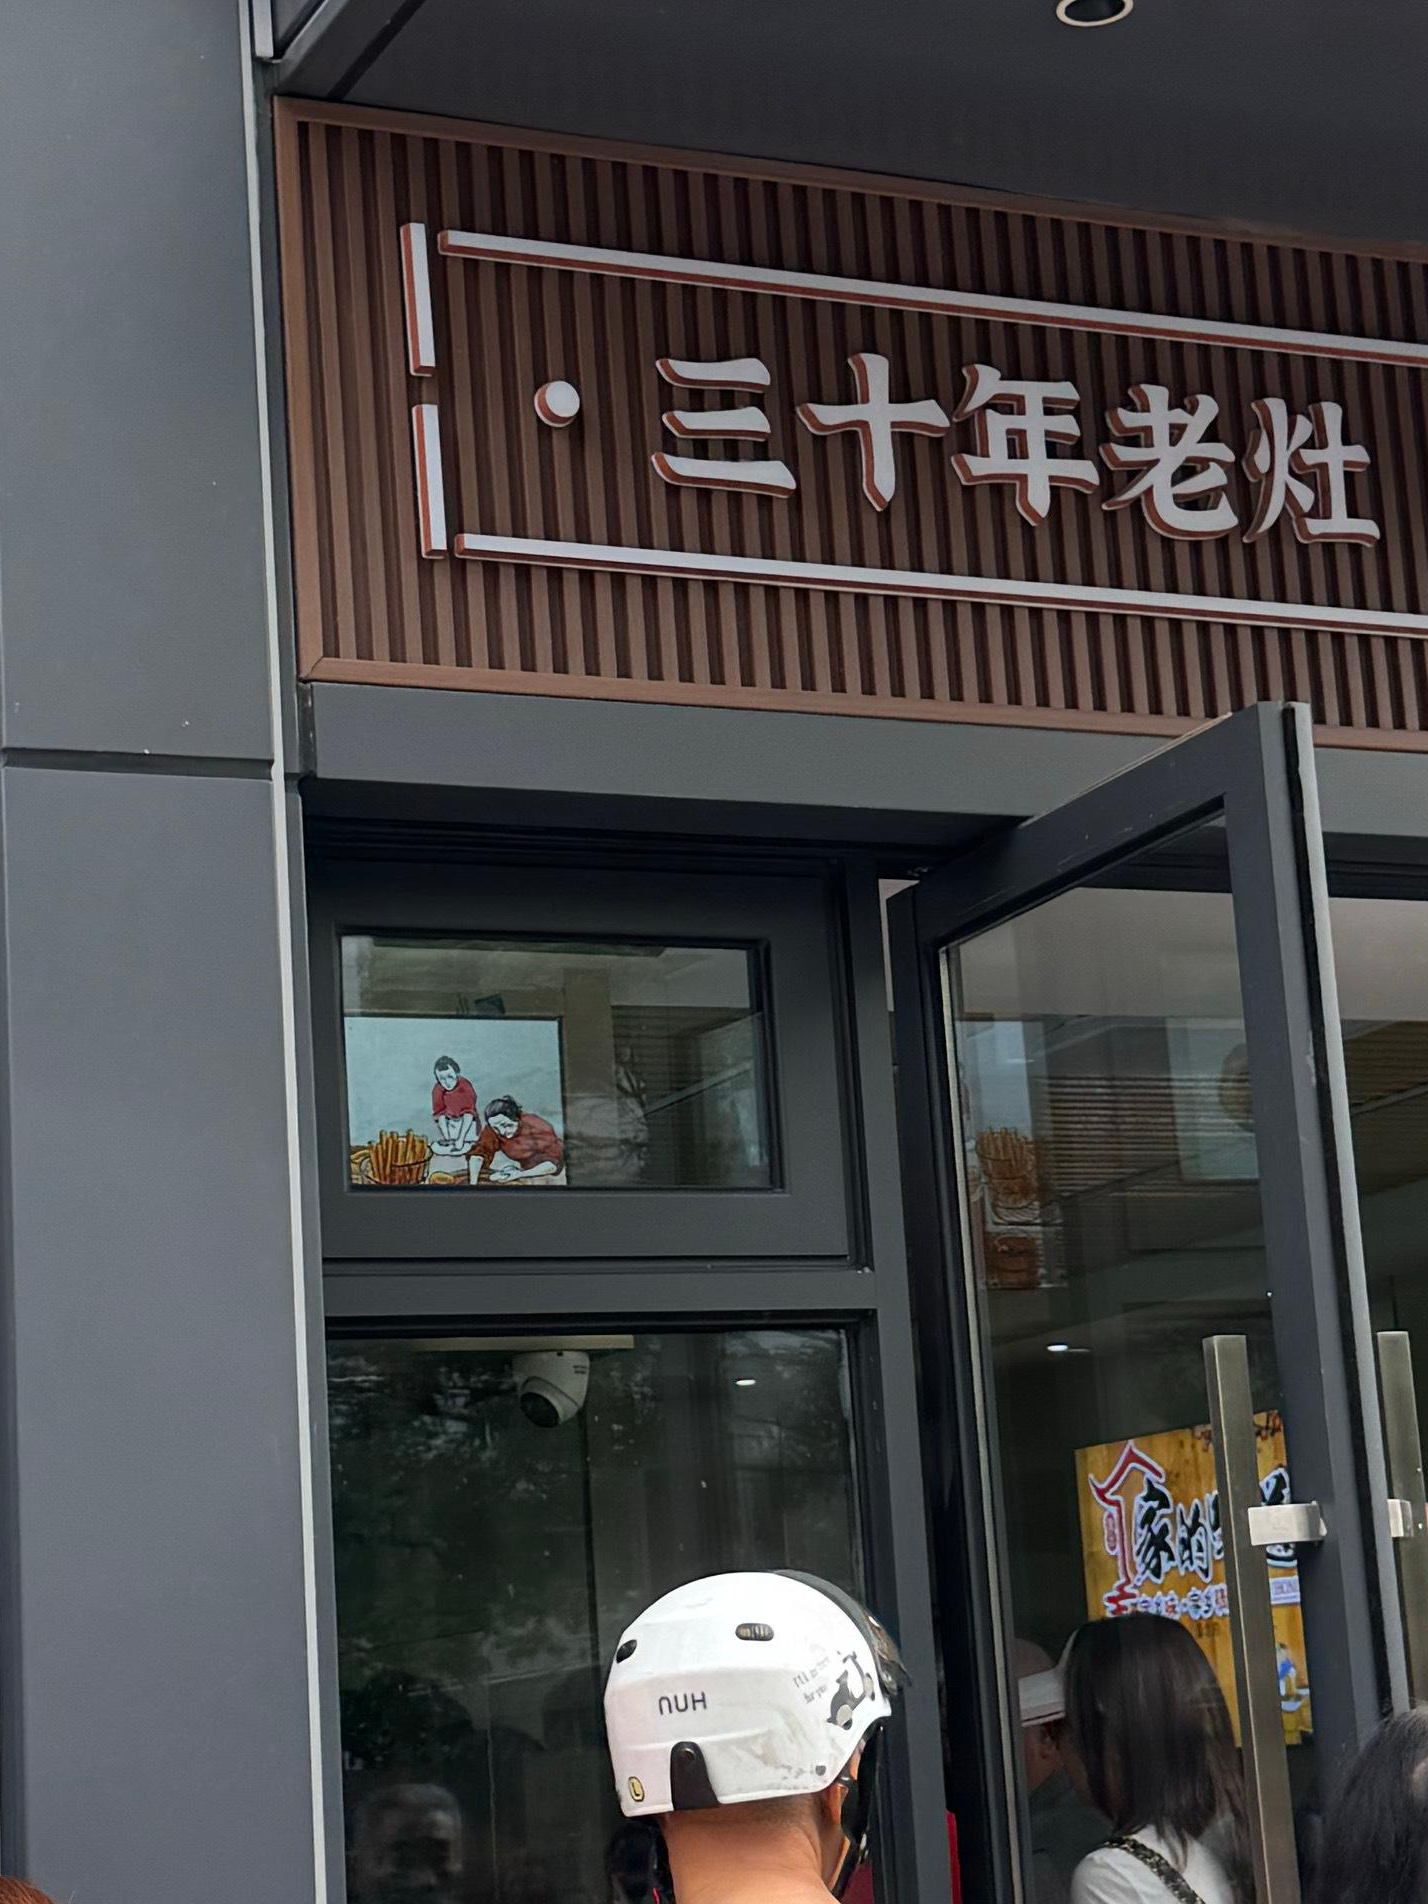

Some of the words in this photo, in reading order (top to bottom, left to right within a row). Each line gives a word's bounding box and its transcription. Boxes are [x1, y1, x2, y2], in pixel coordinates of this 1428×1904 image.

[649, 350, 1381, 549] 三十年老灶
